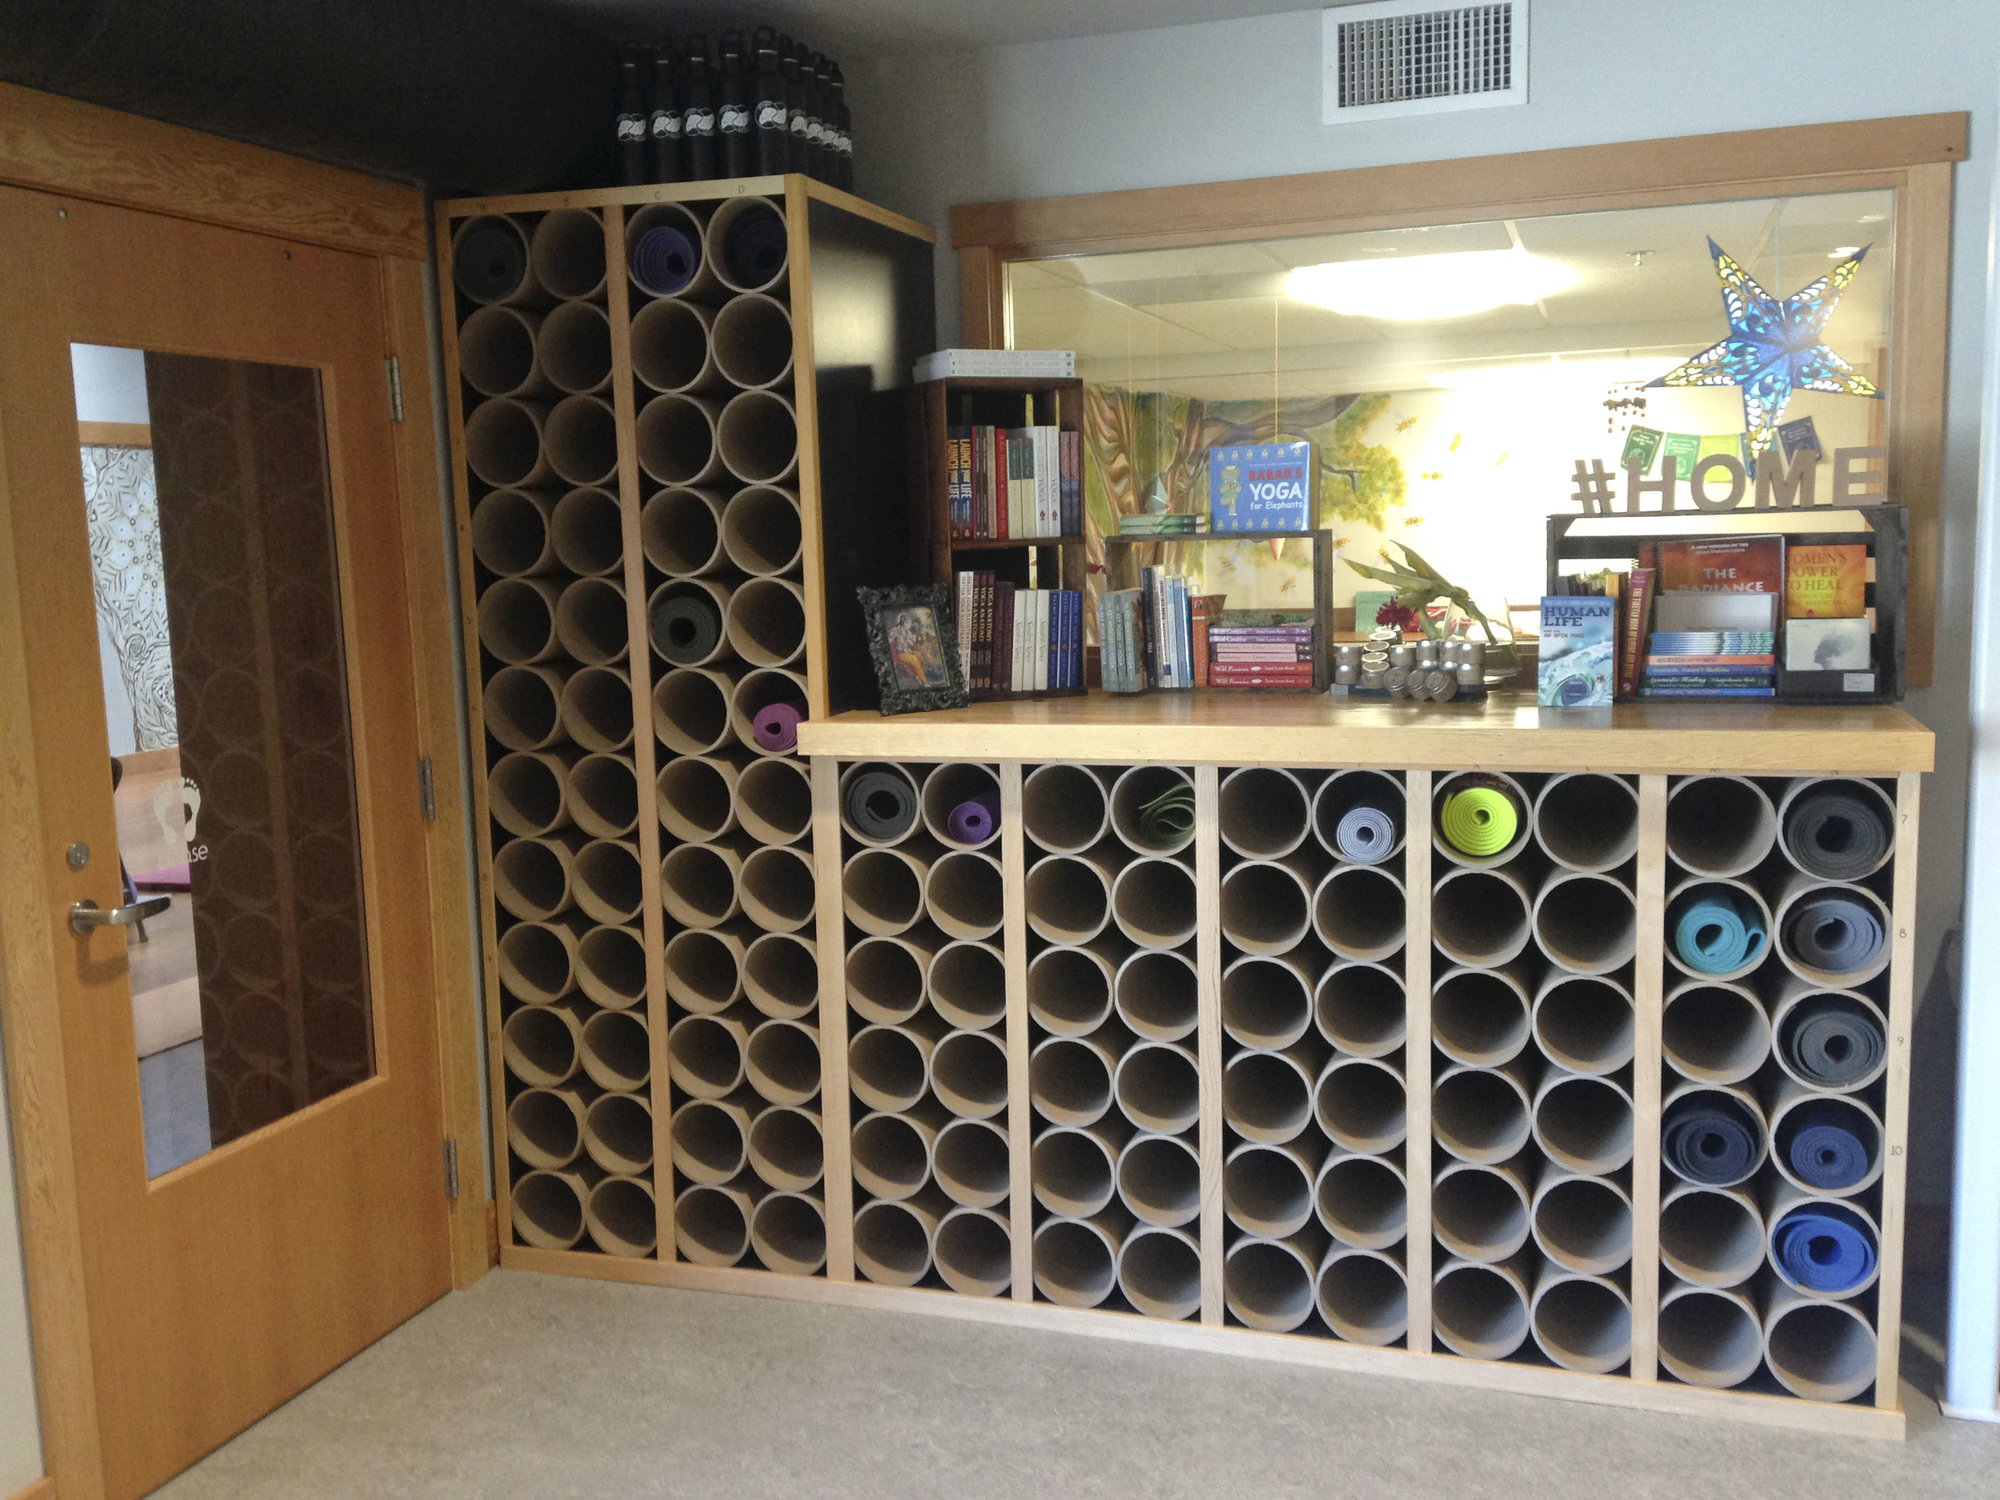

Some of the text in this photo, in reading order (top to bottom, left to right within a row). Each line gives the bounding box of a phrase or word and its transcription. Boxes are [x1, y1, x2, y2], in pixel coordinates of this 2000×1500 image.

[960, 439, 972, 469] LAUNCH
[949, 484, 960, 500] LIFE
[960, 484, 972, 499] LIFE
[1249, 481, 1303, 502] YOGA
[1249, 500, 1303, 511] for Elephants
[1703, 568, 1737, 579] THE
[1805, 579, 1845, 591] HEAL
[1544, 606, 1610, 617] HUMAN
[1544, 617, 1583, 627] LIFE
[1900, 815, 1908, 825] 7
[1899, 928, 1907, 939] 8
[1897, 1036, 1905, 1046] 9
[1890, 1146, 1903, 1157] 10
